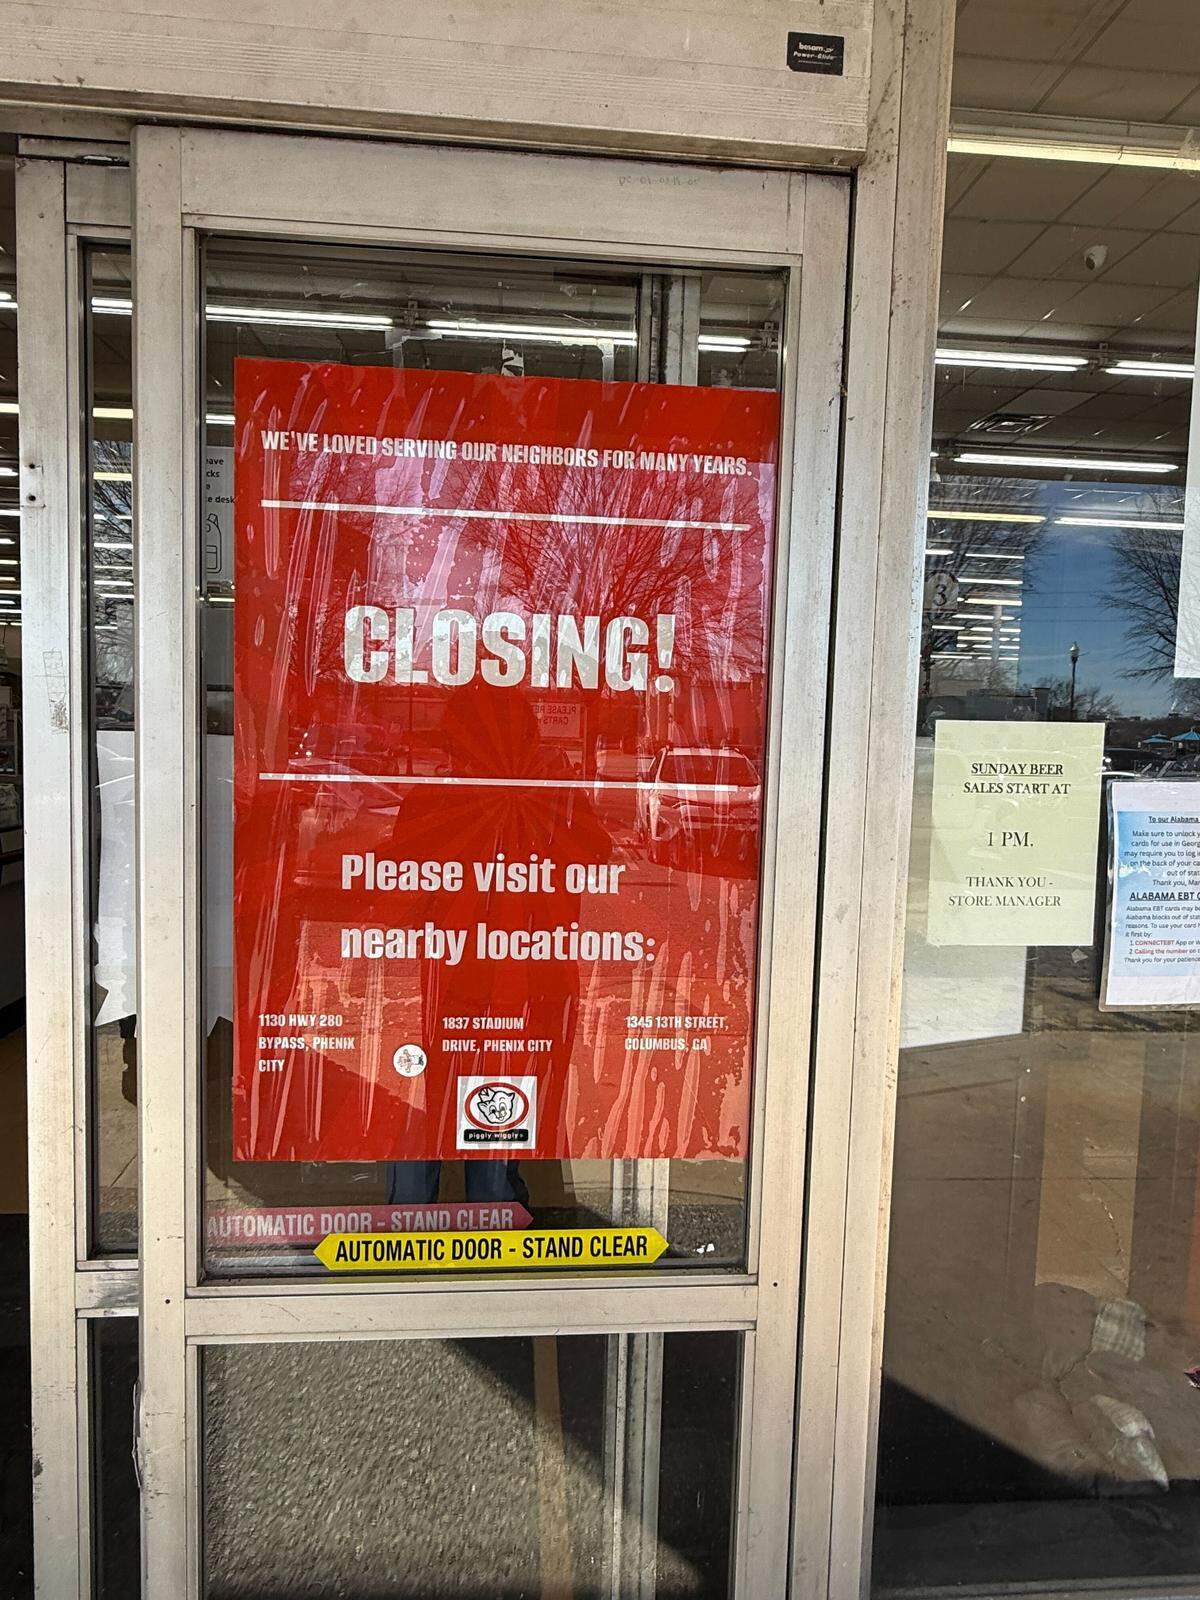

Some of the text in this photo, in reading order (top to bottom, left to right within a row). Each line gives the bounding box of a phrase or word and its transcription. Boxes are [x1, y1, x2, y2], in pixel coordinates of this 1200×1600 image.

[261, 430, 753, 476] WE'VE LOVED SERVING OUR NEIGHBORS FOR MANY YEARS.
[934, 584, 947, 606] 3
[344, 604, 676, 692] CLOSING!
[971, 763, 1064, 776] SUNDAY BEER
[964, 782, 1071, 794] SALES START AT
[988, 832, 1034, 848] 1 PM.
[1140, 850, 1163, 858] require
[1186, 850, 1196, 858] log
[342, 852, 626, 894] Please visit our
[966, 876, 1015, 888] THANK
[1018, 876, 1046, 888] YOU
[949, 896, 1061, 907] STORE MANAGER
[1130, 892, 1176, 901] ALABAMA
[1178, 892, 1194, 901] EBT
[341, 922, 656, 966] nearby locations:
[258, 1014, 343, 1026] 1130 HWY 280
[442, 1017, 524, 1030] 1837 STADIUM
[625, 1016, 729, 1031] 1345 13TH STREET,
[258, 1037, 356, 1052] BYPASS, PHENIX
[442, 1040, 552, 1054] DRIVE, PHENIX CITY
[624, 1038, 708, 1053] COLUMBUS, GA
[258, 1060, 285, 1072] CITY
[468, 1132, 492, 1140] piggly
[207, 1213, 314, 1237] AUTOMATIC
[320, 1212, 372, 1234] DOOR
[391, 1210, 450, 1232] STAND
[456, 1208, 514, 1230] CLEAR
[335, 1238, 444, 1262] AUTOMATIC
[452, 1238, 502, 1260] DOOR
[522, 1236, 584, 1259] STAND
[590, 1235, 648, 1258] CLEAR
